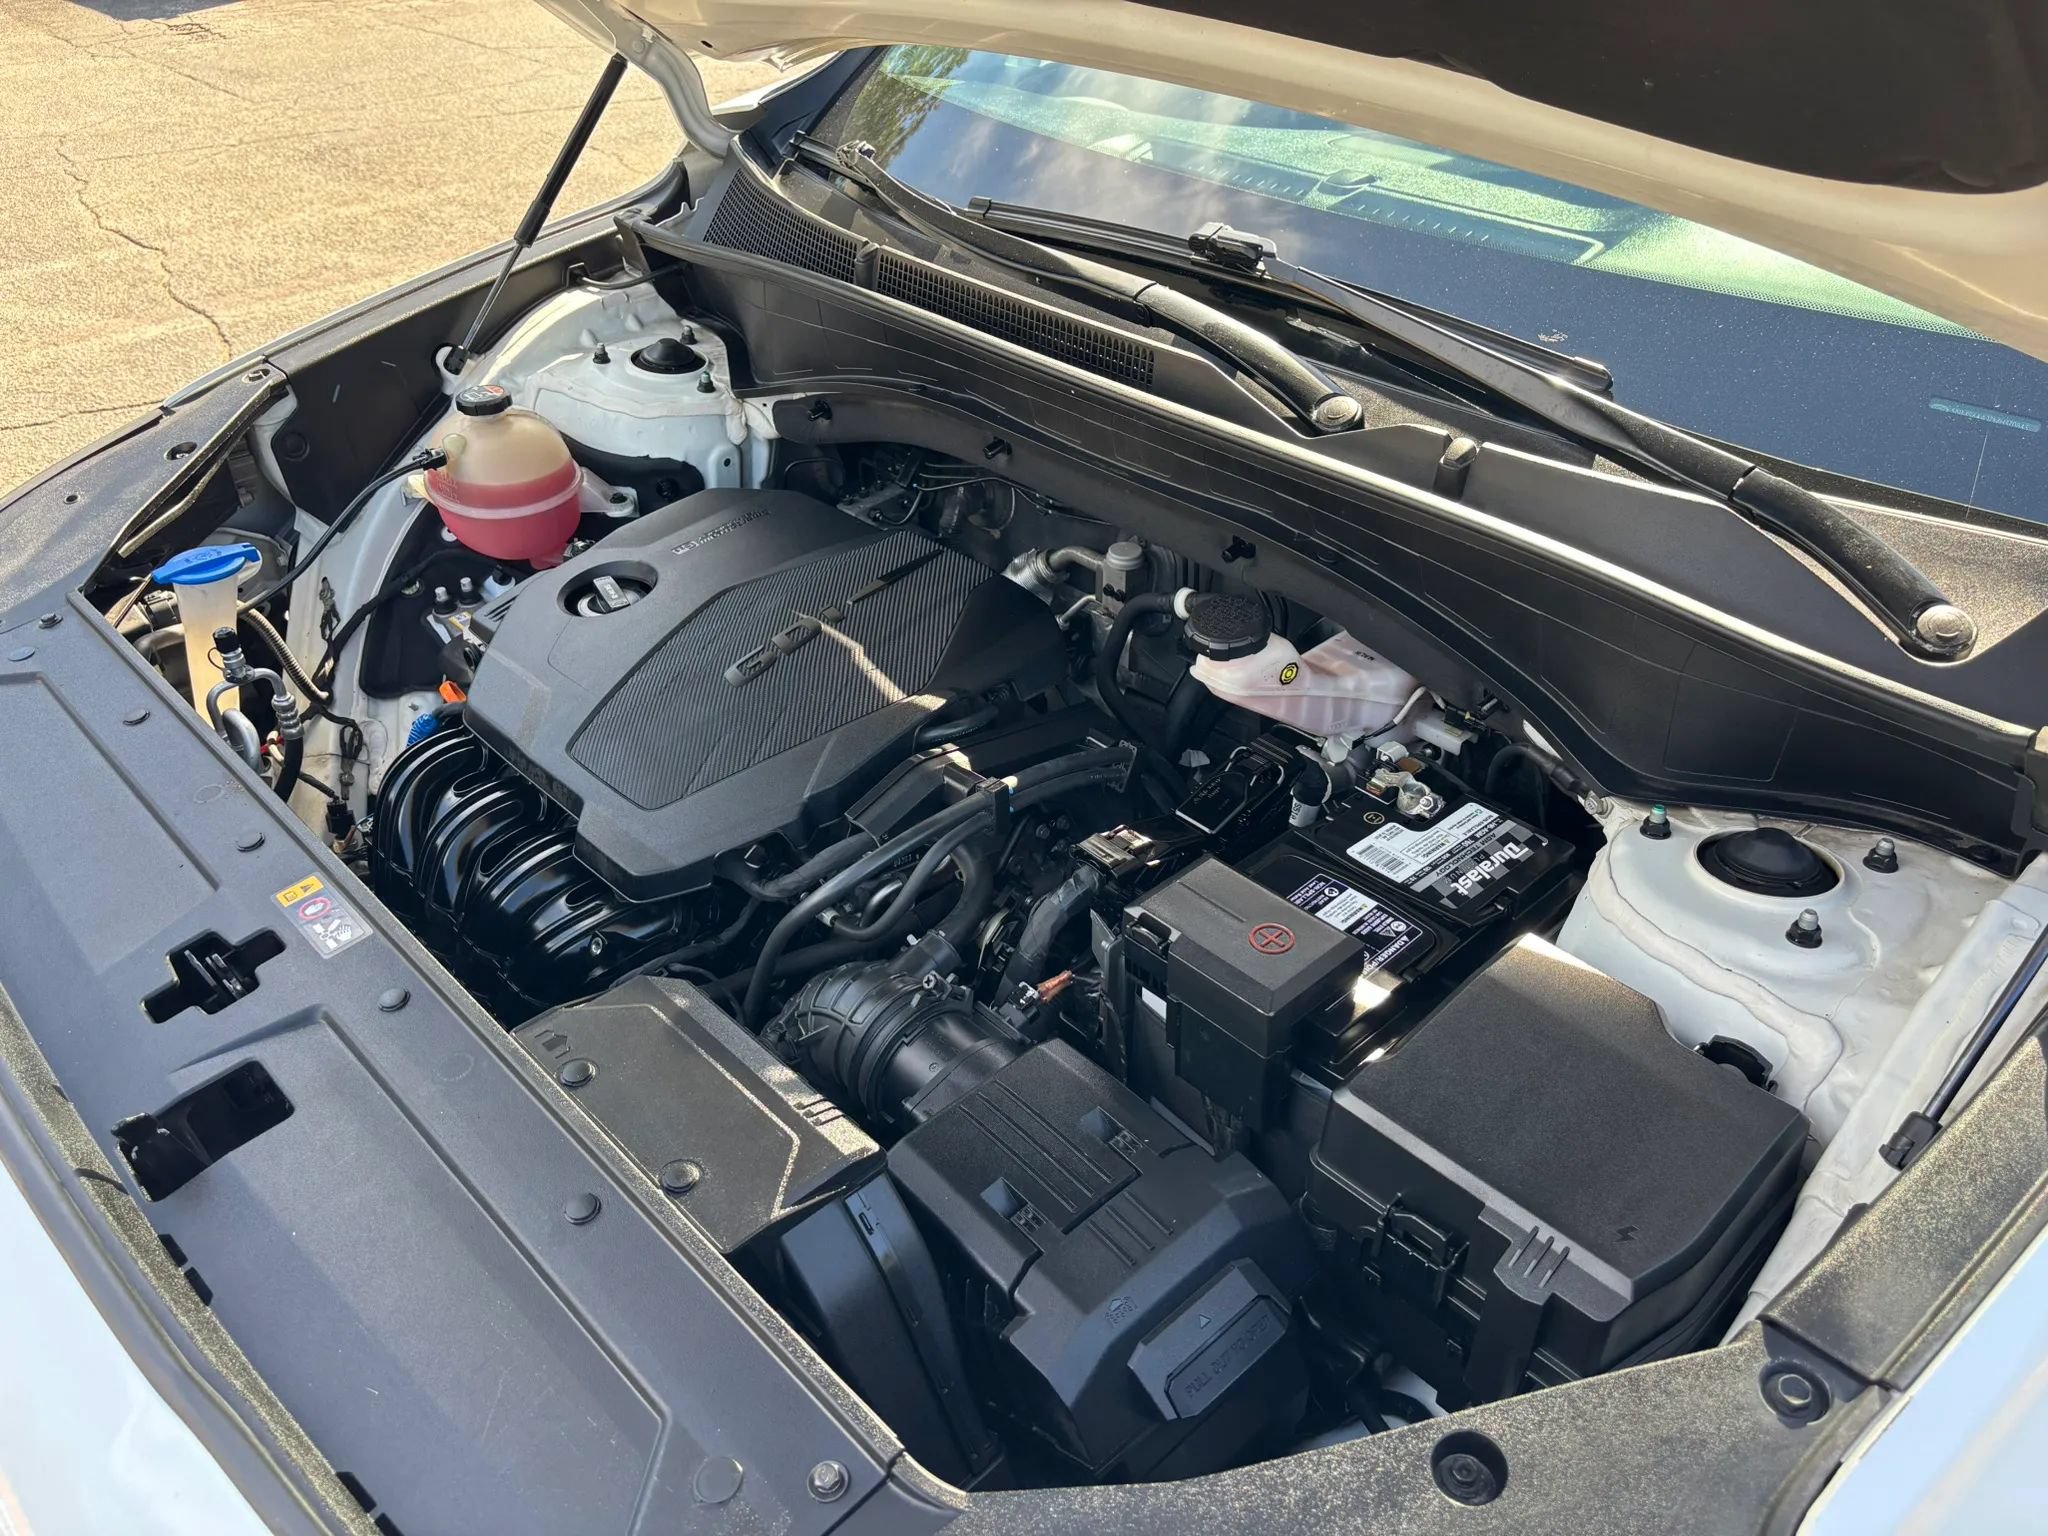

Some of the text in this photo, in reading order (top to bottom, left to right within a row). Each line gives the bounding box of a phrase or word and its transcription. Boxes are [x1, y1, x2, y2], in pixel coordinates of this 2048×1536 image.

[1478, 832, 1498, 845] AGM
[1432, 844, 1481, 877] TECHNOLOGY
[1443, 853, 1487, 884] PLATINUM
[1447, 840, 1529, 896] Duralast
[1184, 1371, 1212, 1398] PULL
